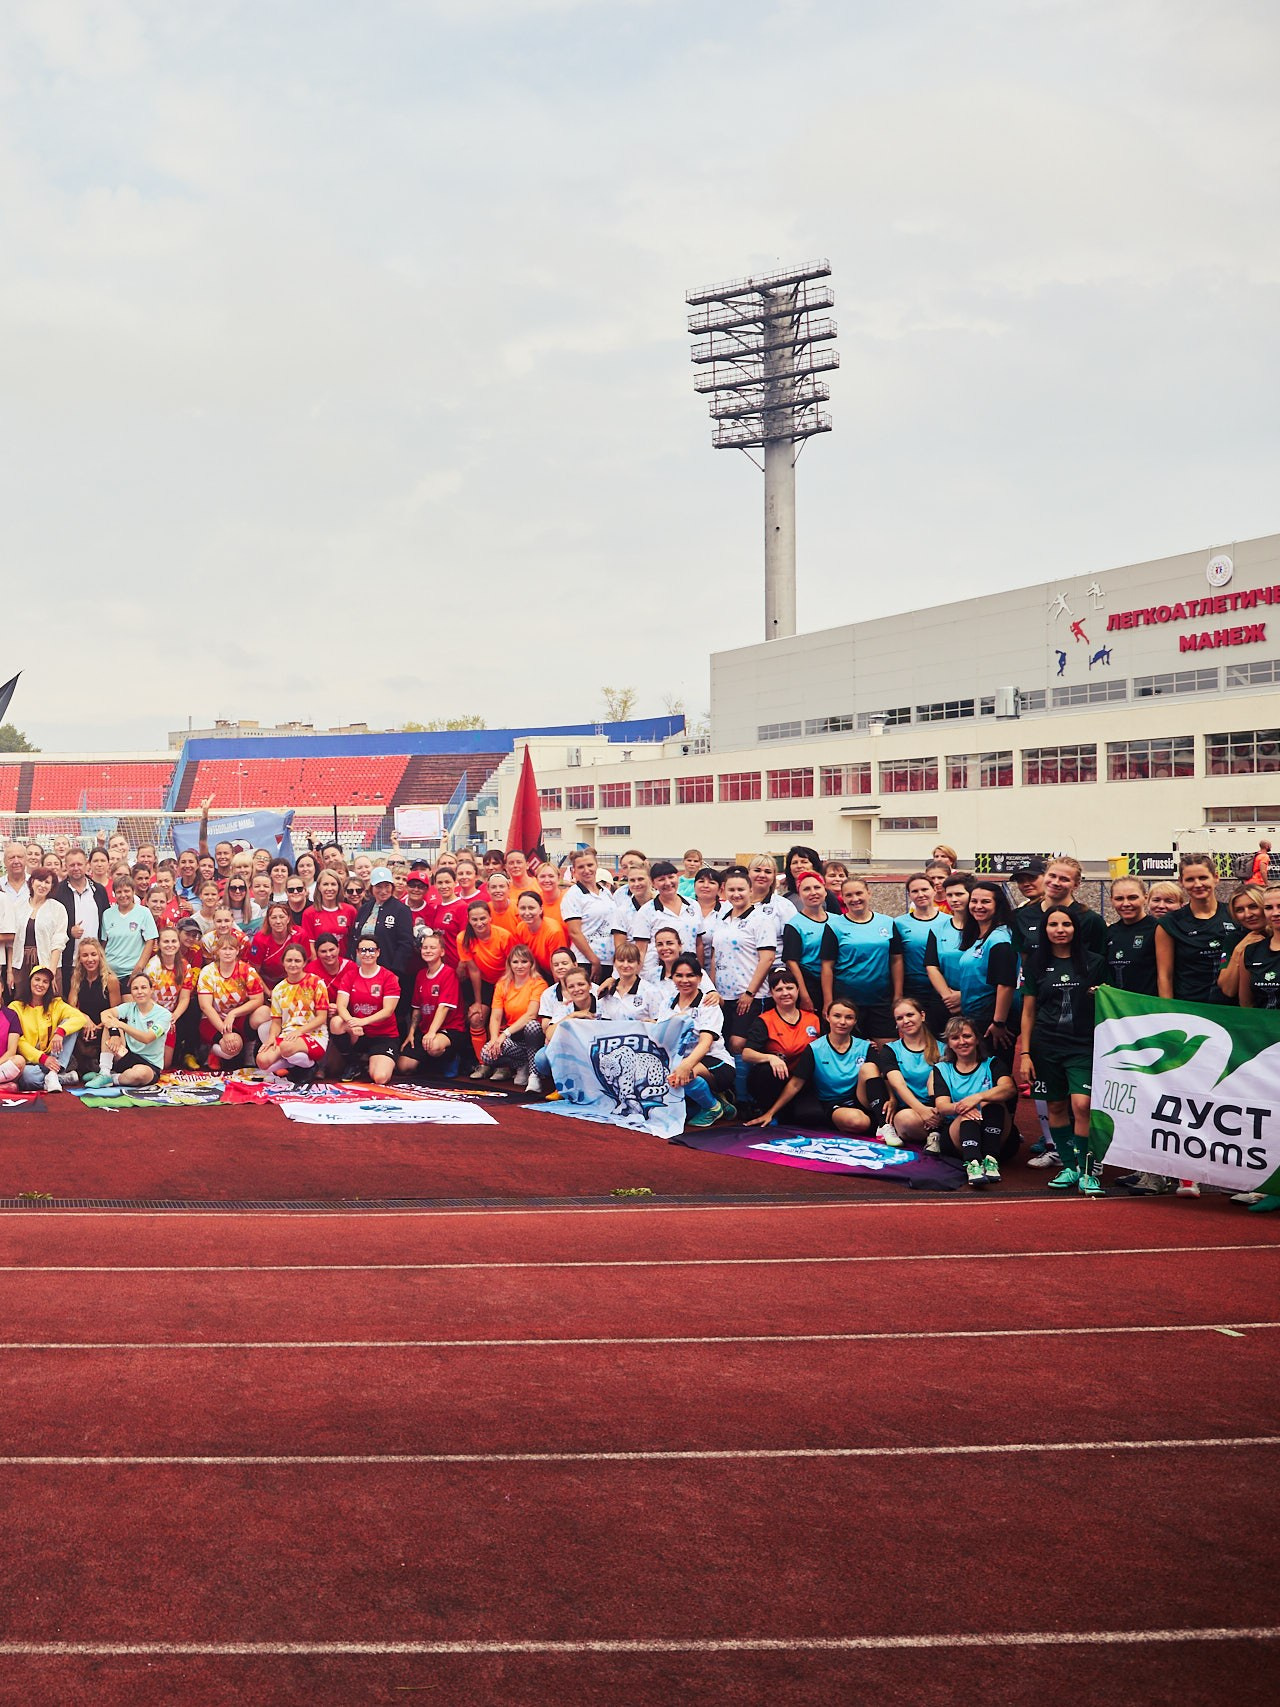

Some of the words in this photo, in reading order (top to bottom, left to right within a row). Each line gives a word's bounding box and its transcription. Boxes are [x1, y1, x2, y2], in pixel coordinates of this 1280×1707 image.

[1179, 623, 1266, 653] МАНЕЖ
[1034, 1080, 1048, 1094] 25
[1102, 1079, 1138, 1115] 2025
[1151, 1094, 1272, 1140] ДУСТ
[1151, 1128, 1268, 1170] moms
